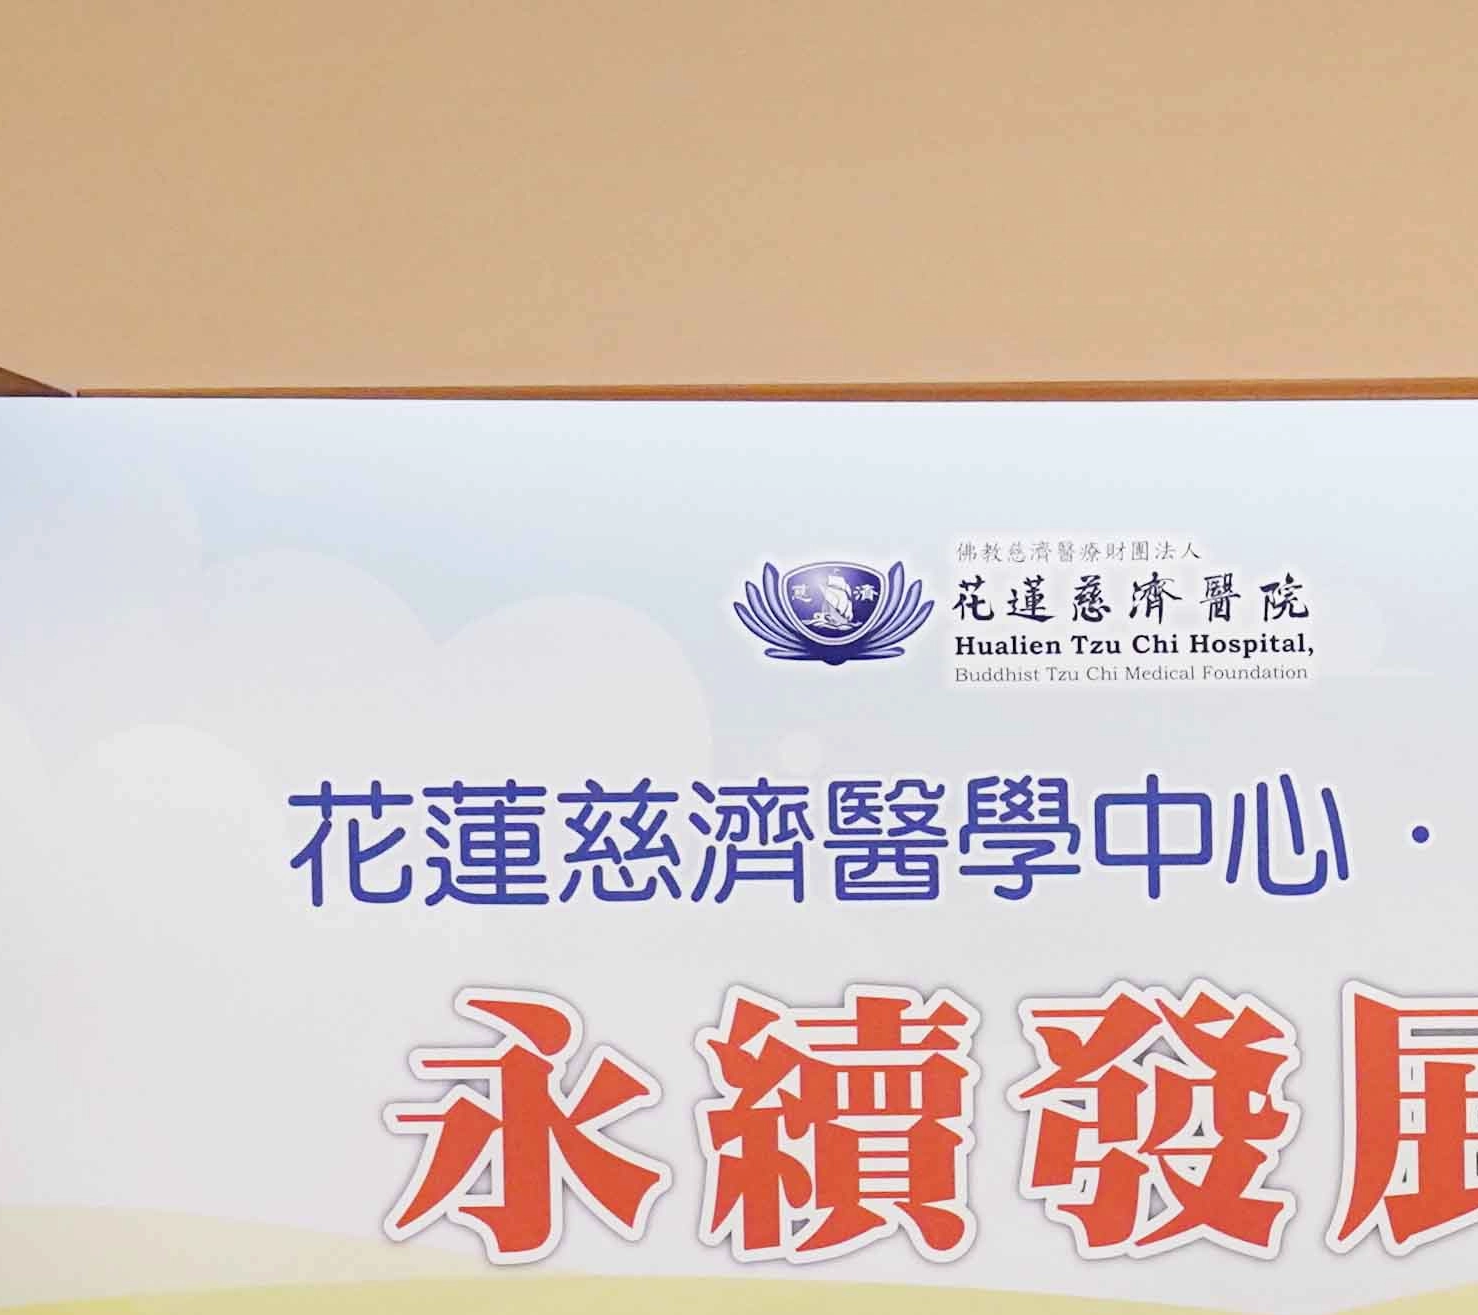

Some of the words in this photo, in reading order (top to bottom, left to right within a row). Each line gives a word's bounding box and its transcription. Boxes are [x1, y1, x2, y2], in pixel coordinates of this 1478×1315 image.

[956, 540, 1202, 564] 佛教慈濟醫療財團法人
[952, 571, 1310, 625] 花蓮慈濟醫院
[955, 635, 1061, 655] Hualien
[1070, 634, 1121, 655] Tzu
[1132, 633, 1178, 654] Chi
[1189, 632, 1314, 659] Hospital,
[955, 666, 1039, 683] Buddhist
[1046, 666, 1079, 682] Tzu
[1086, 665, 1117, 682] Chi
[1125, 665, 1195, 681] Medical
[1203, 664, 1307, 681] Foundation
